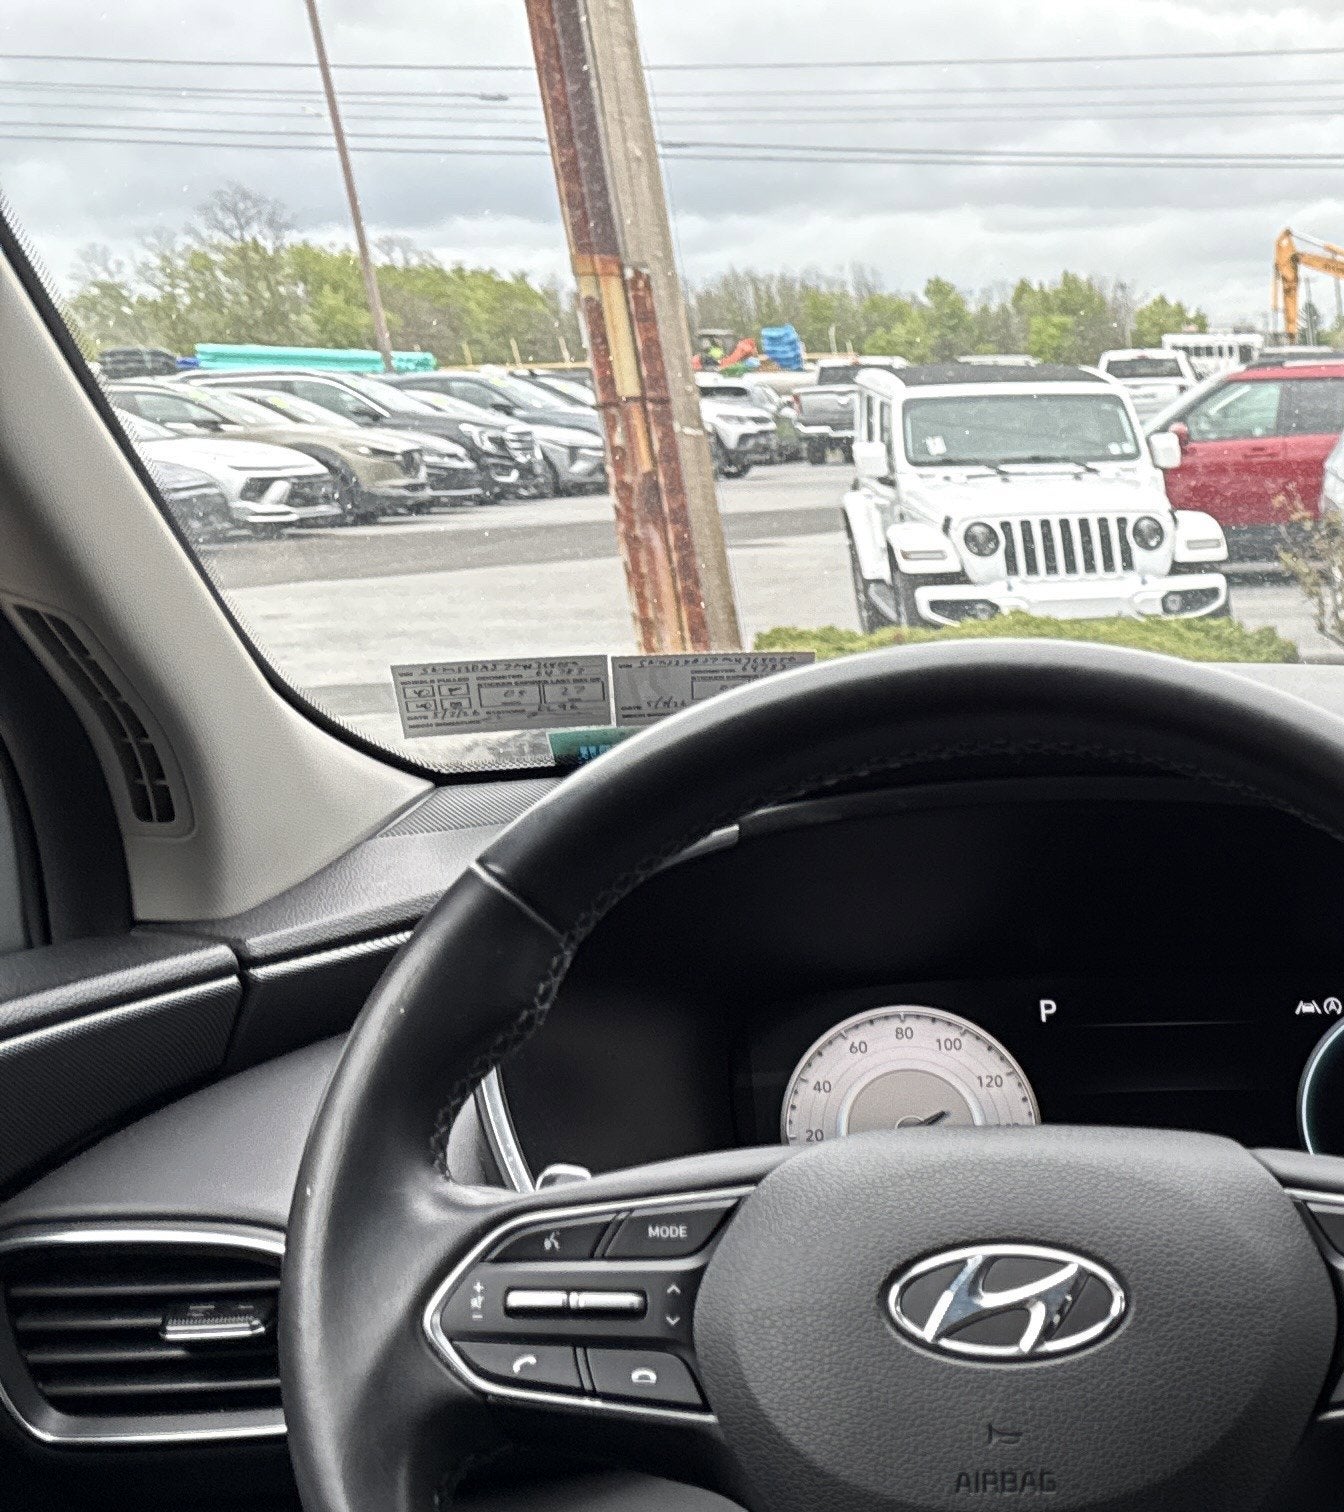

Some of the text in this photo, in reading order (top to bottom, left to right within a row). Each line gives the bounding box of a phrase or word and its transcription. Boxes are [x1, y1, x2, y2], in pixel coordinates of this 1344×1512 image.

[1039, 1000, 1057, 1022] P
[894, 1027, 914, 1040] 80
[849, 1041, 868, 1054] 60
[935, 1038, 963, 1051] 100
[812, 1080, 832, 1093] 40
[976, 1075, 1004, 1089] 120
[805, 1129, 824, 1142] 20
[648, 1225, 687, 1238] MODE
[955, 1469, 1058, 1494] AIRBAG
